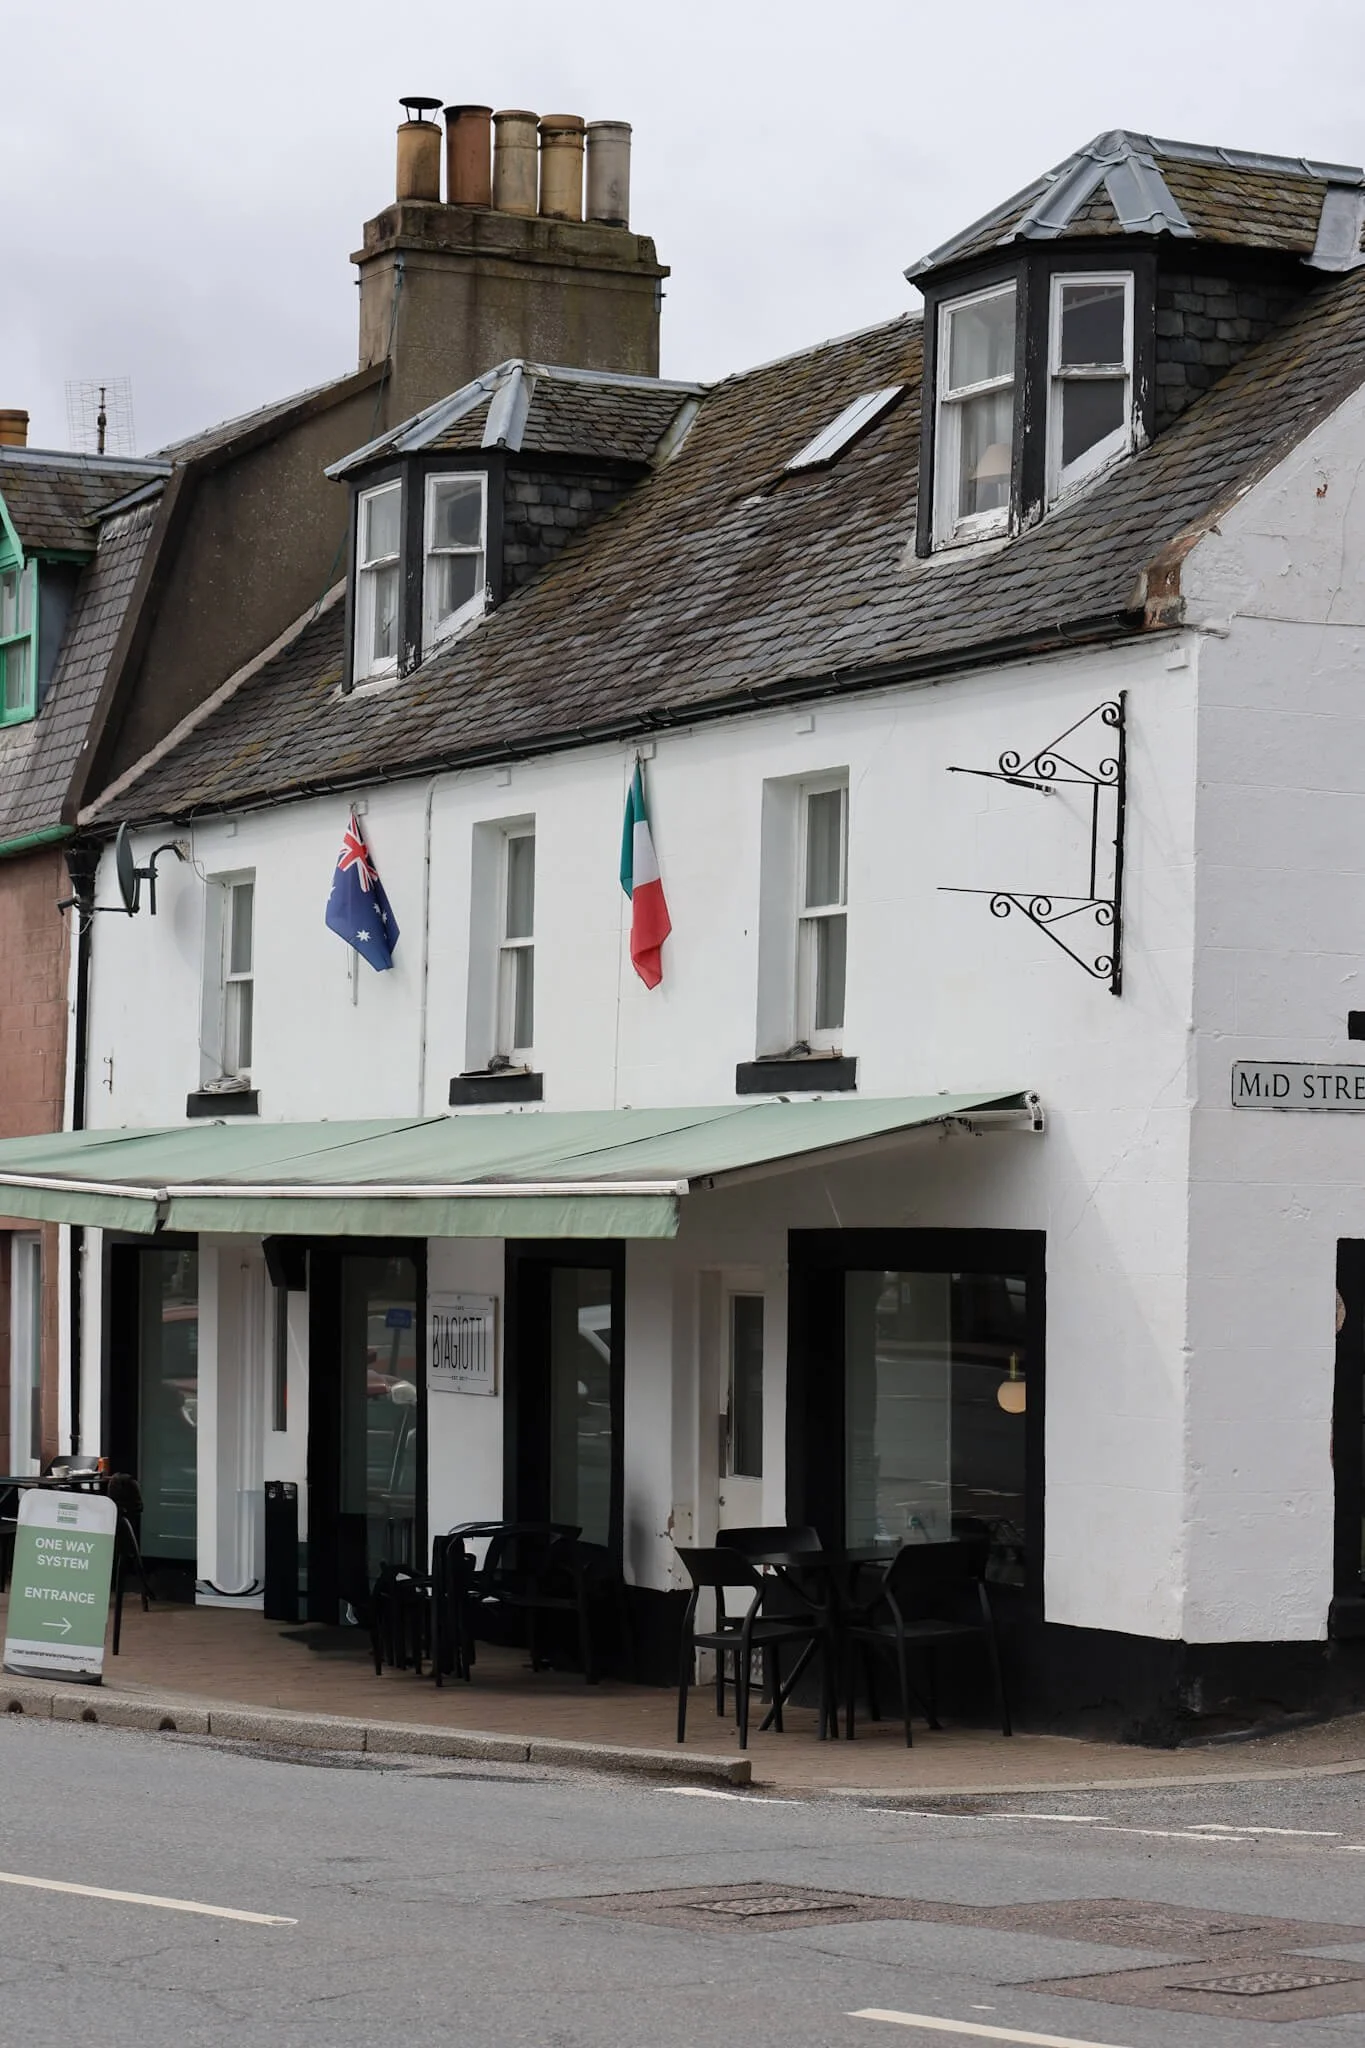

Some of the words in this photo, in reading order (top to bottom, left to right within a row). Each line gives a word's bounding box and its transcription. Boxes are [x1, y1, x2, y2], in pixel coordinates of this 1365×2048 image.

[432, 1314, 486, 1373] BIAGIOTTI
[35, 1537, 63, 1551] ONE
[65, 1540, 95, 1554] WAY
[37, 1554, 89, 1571] SYSTEM
[24, 1587, 96, 1605] ENTRANCE
